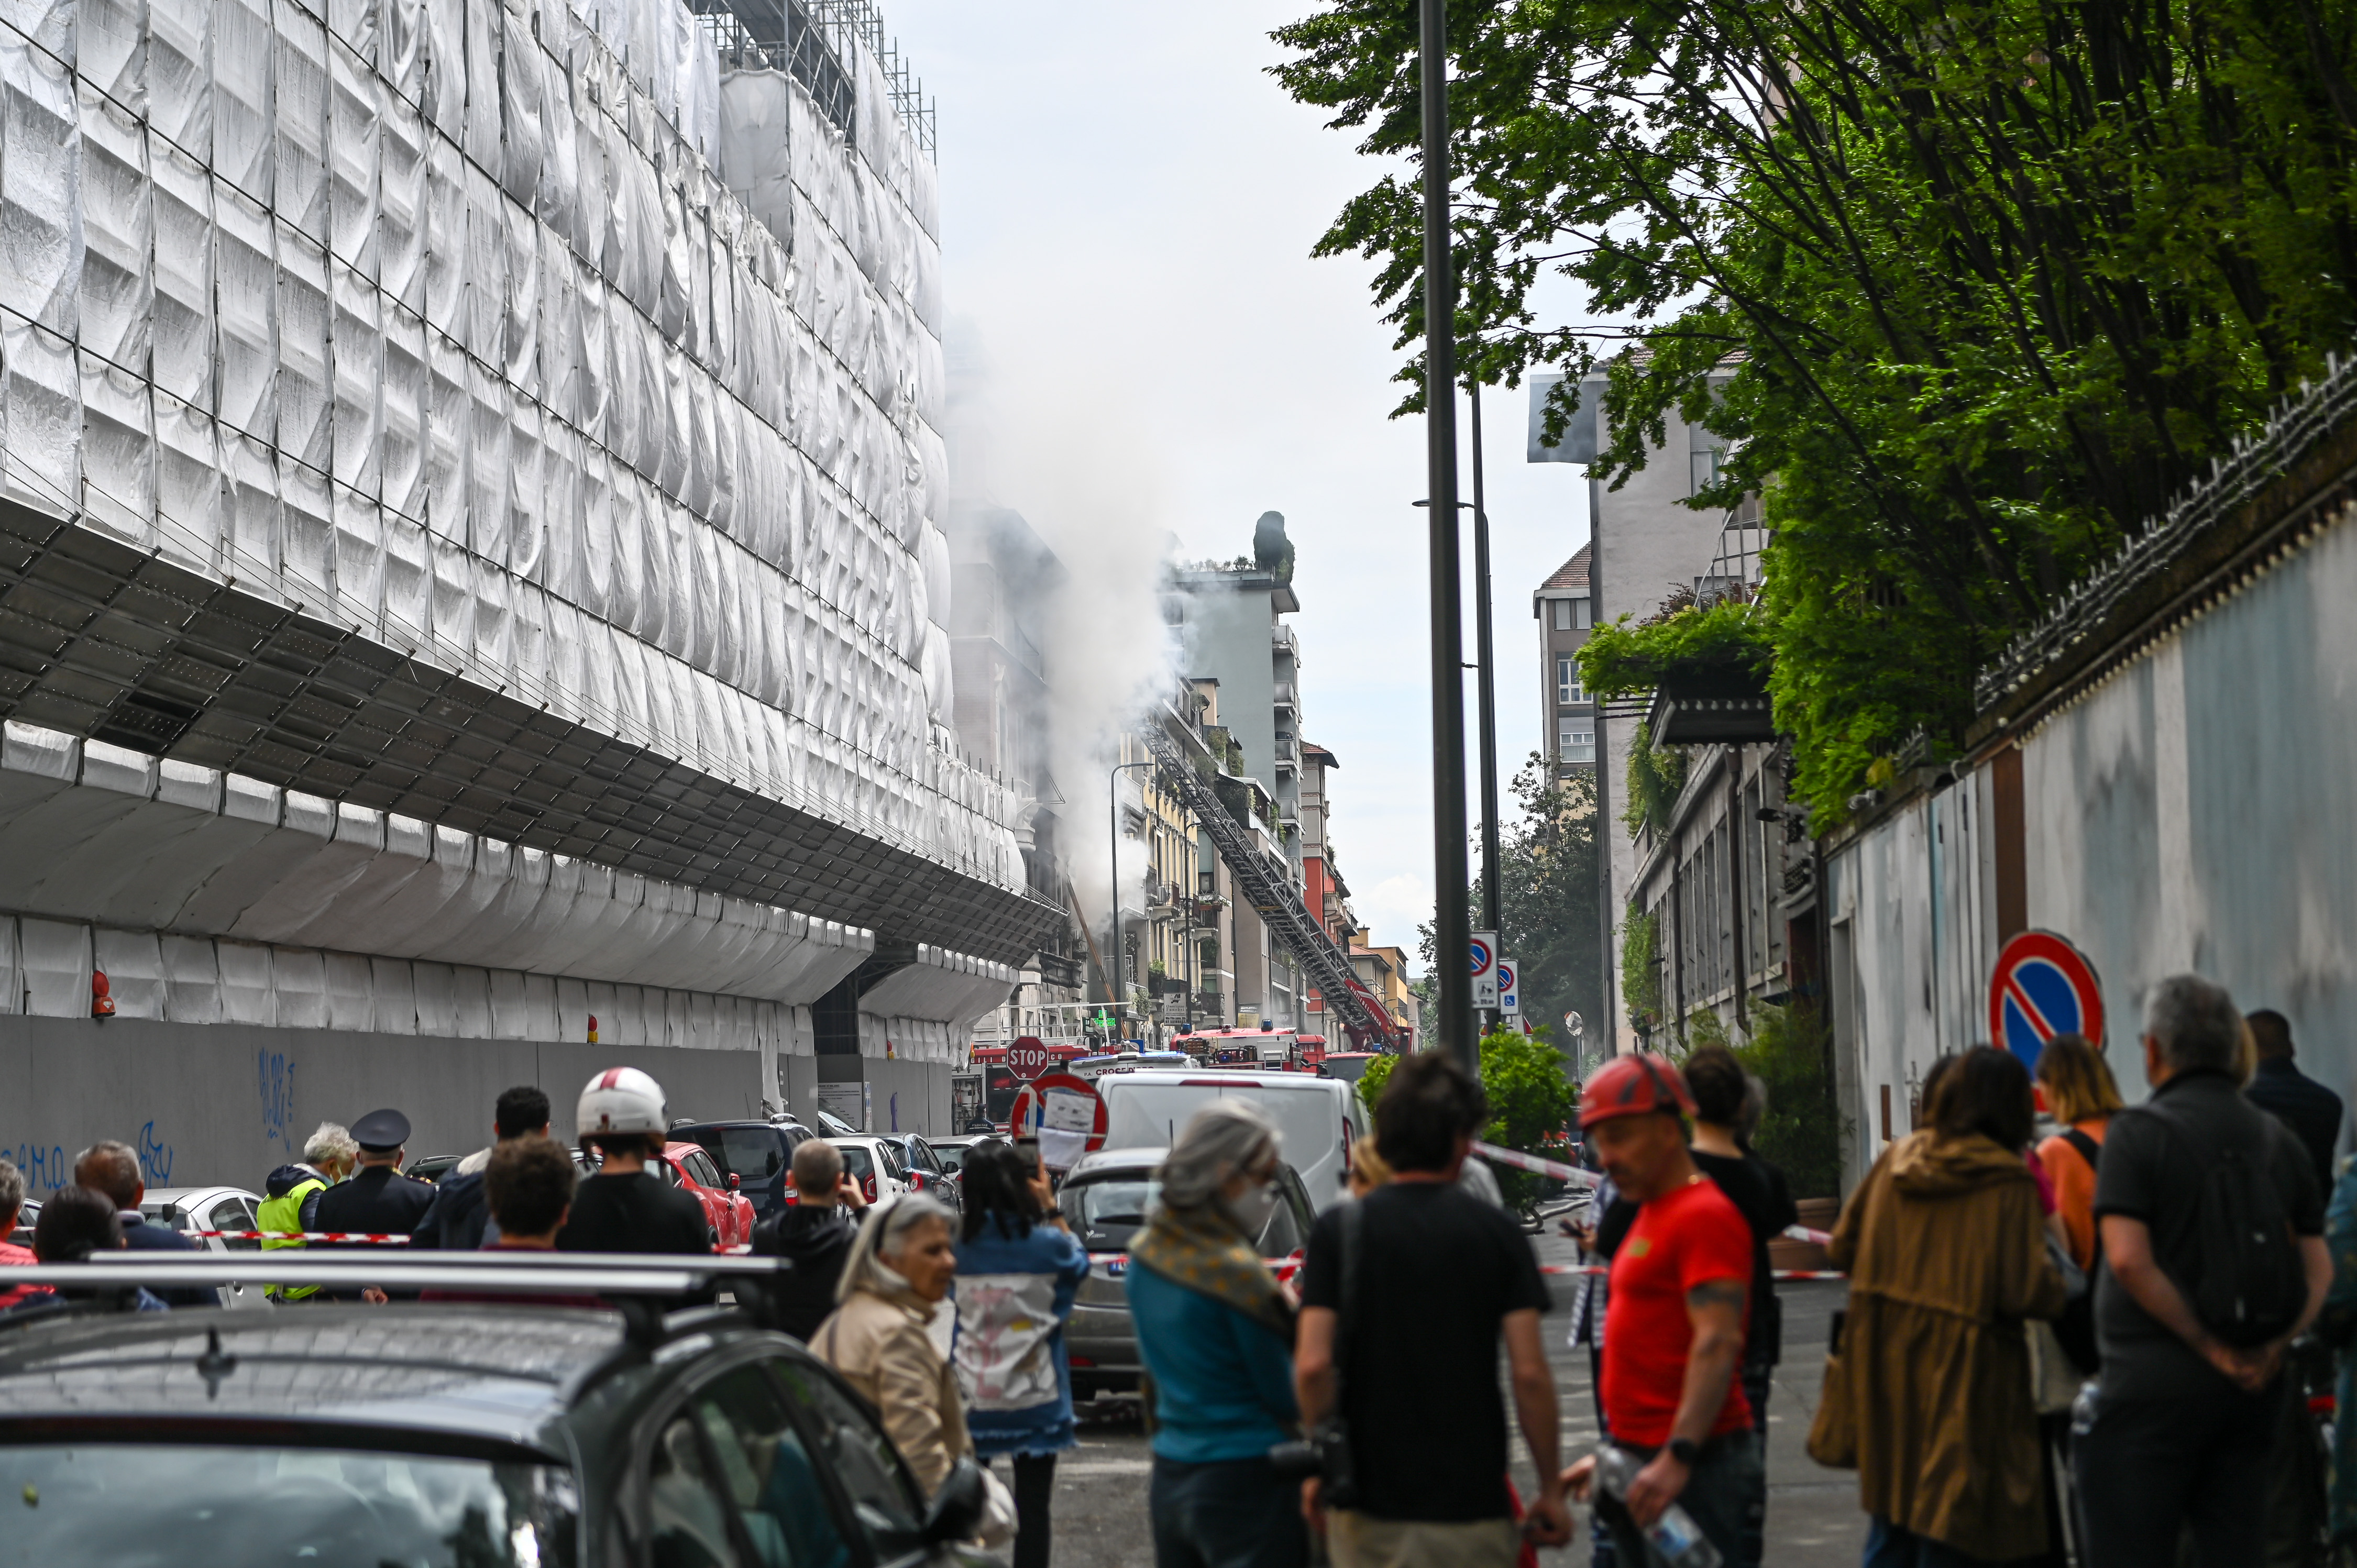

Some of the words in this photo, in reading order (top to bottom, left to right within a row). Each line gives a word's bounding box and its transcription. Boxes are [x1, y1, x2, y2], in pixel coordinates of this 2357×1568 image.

[1350, 986, 1362, 1002] VIGILI
[1369, 1011, 1382, 1026] FUOCO
[1010, 1049, 1046, 1066] STOP
